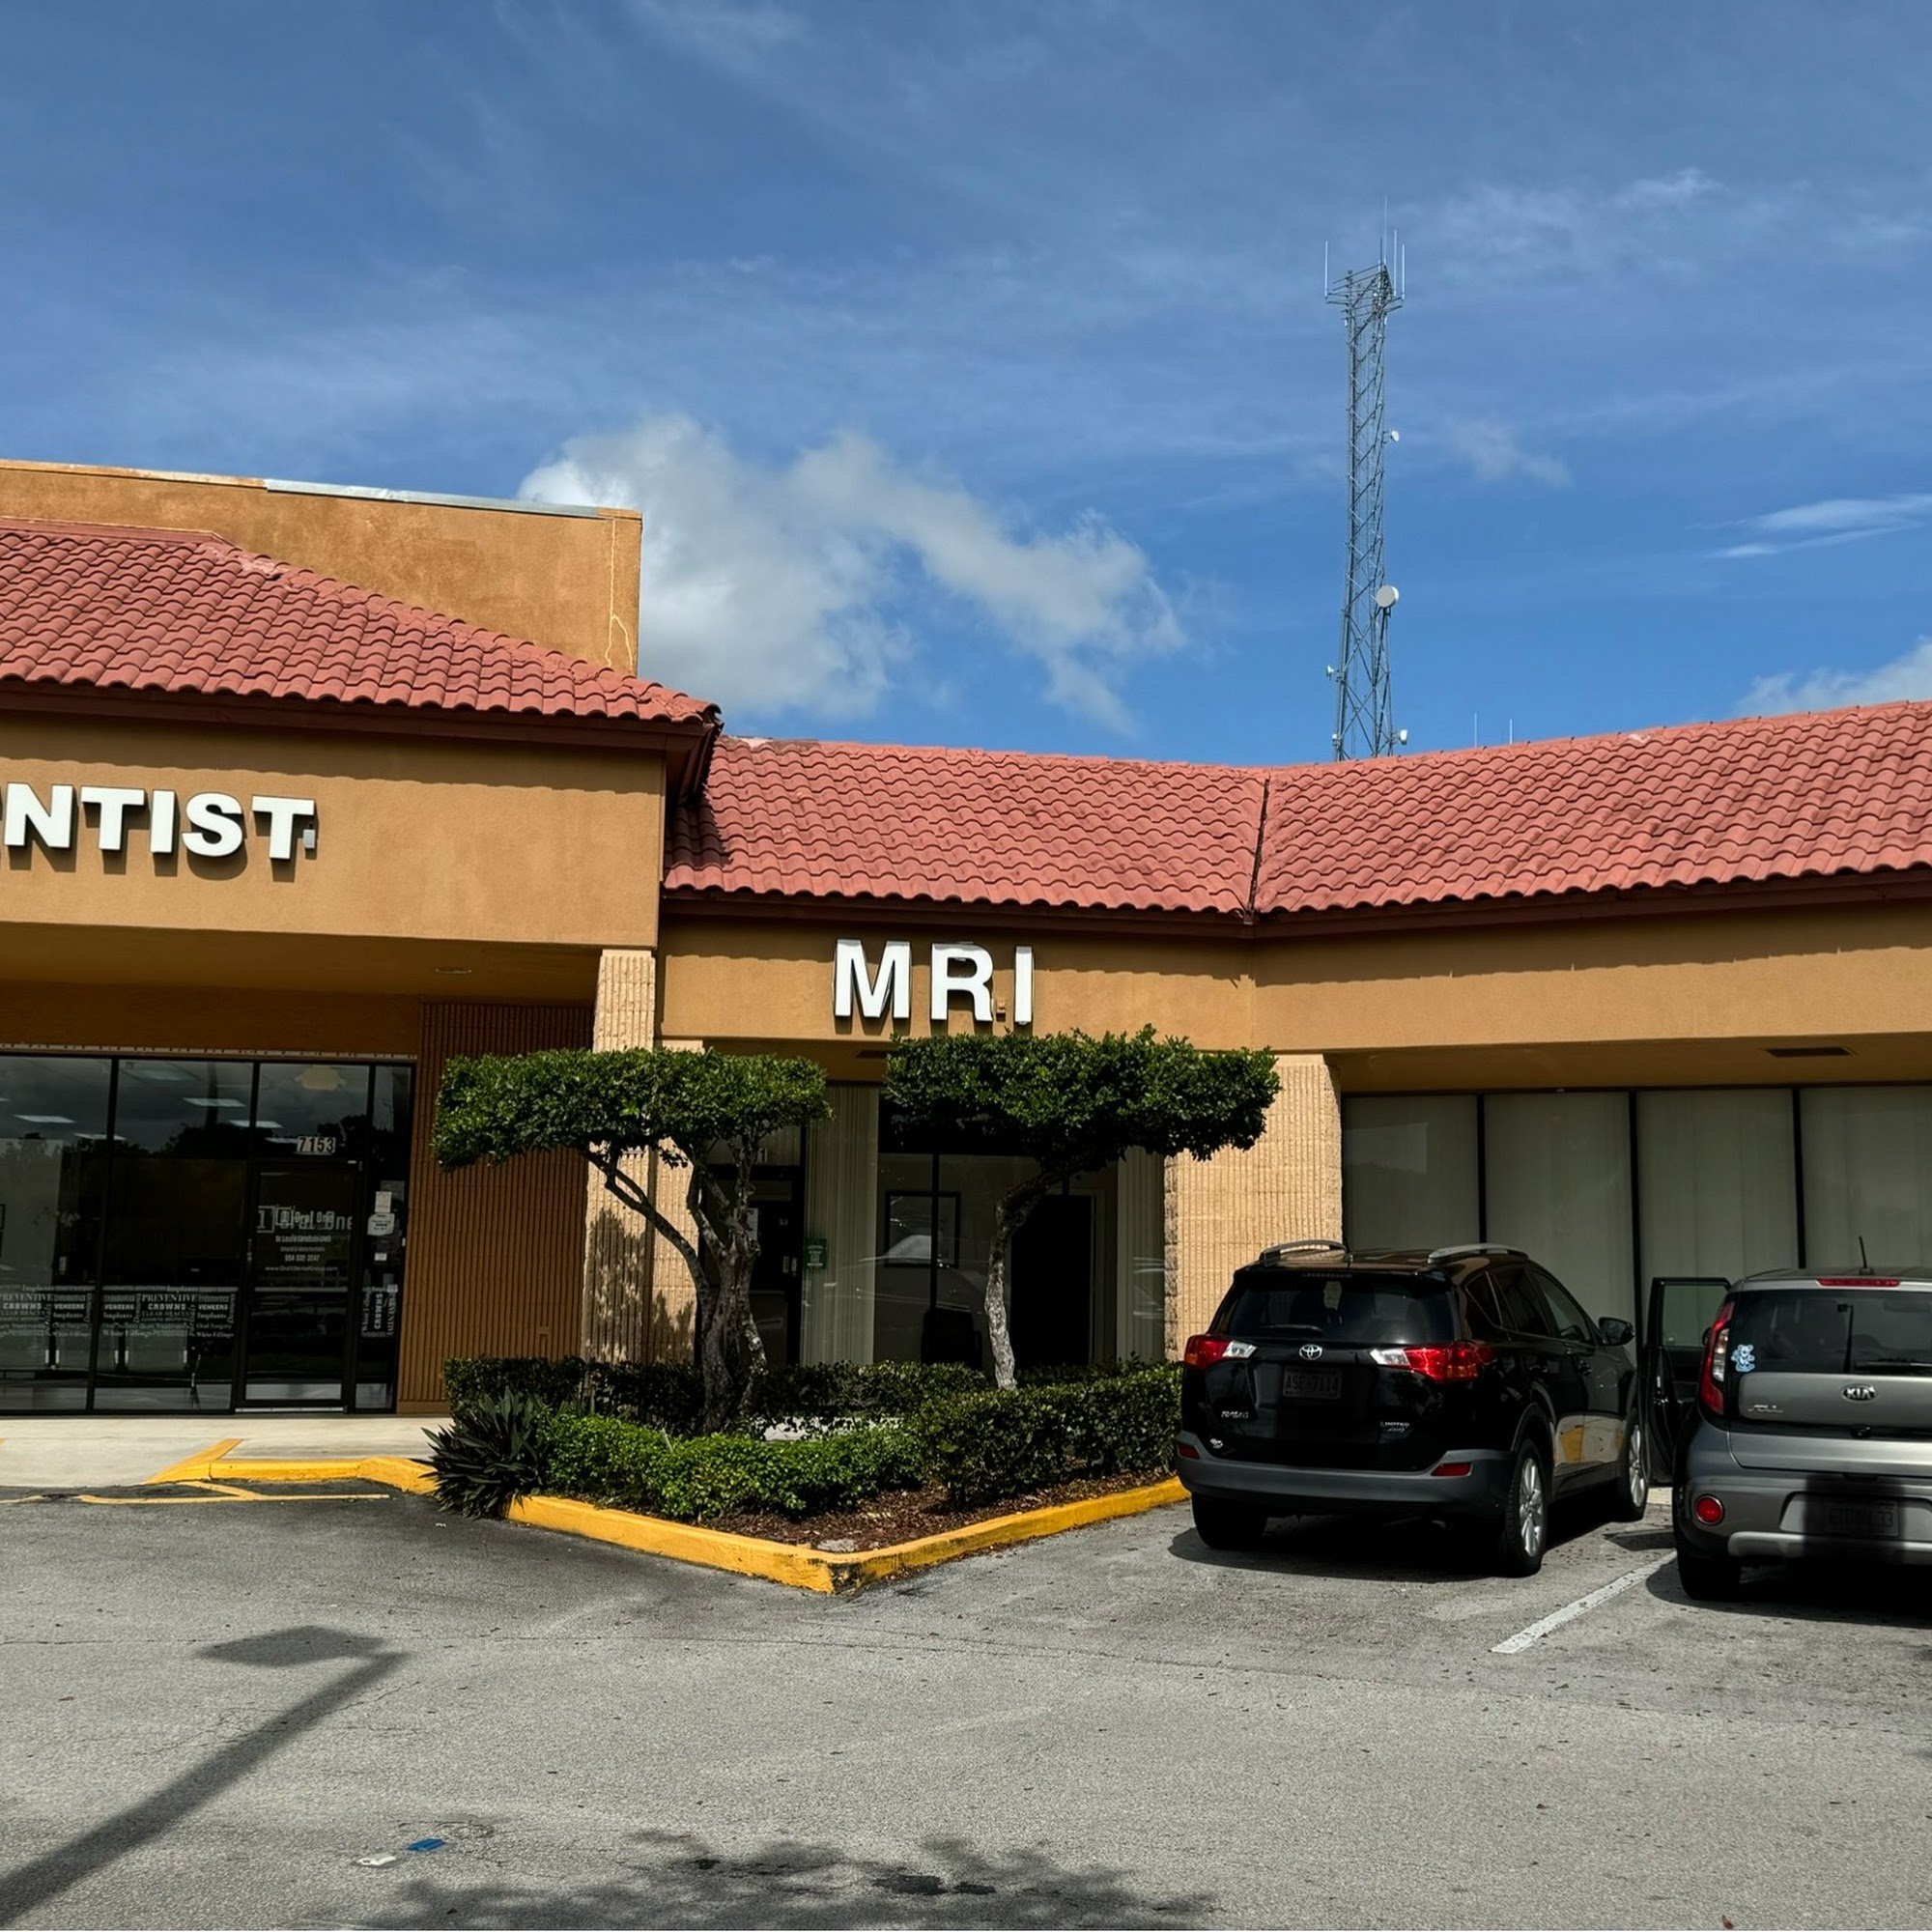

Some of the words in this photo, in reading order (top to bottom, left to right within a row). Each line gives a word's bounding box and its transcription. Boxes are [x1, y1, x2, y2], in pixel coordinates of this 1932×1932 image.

[834, 938, 1034, 1025] MRI
[298, 1136, 334, 1153] 7153
[142, 1293, 196, 1303] PREVENTIVE
[197, 1312, 227, 1321] Implants
[374, 1293, 384, 1330] CROWNS
